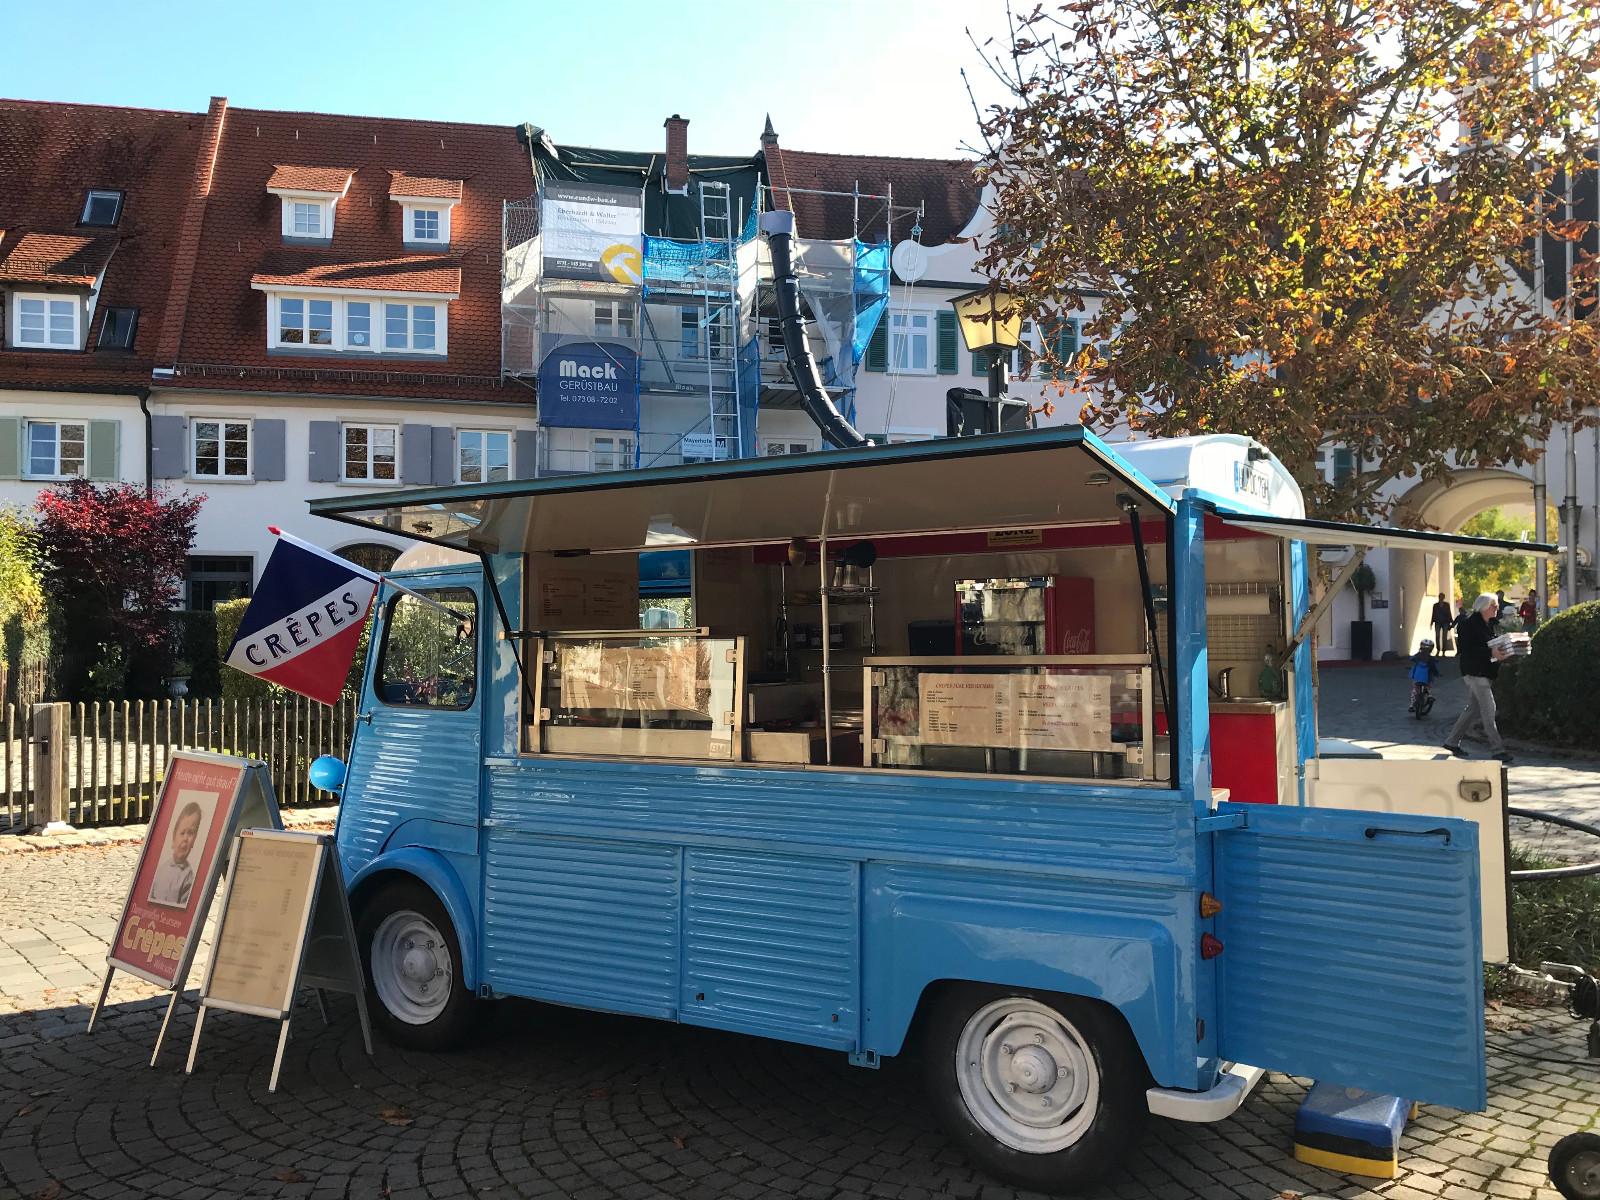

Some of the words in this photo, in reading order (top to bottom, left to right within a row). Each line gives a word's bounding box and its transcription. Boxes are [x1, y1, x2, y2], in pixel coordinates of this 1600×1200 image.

[560, 360, 618, 380] Mack
[559, 379, 618, 392] GERÜSTBAU
[560, 394, 571, 402] Tel.
[245, 592, 360, 667] CRÊPES
[123, 915, 187, 963] Crêpes
